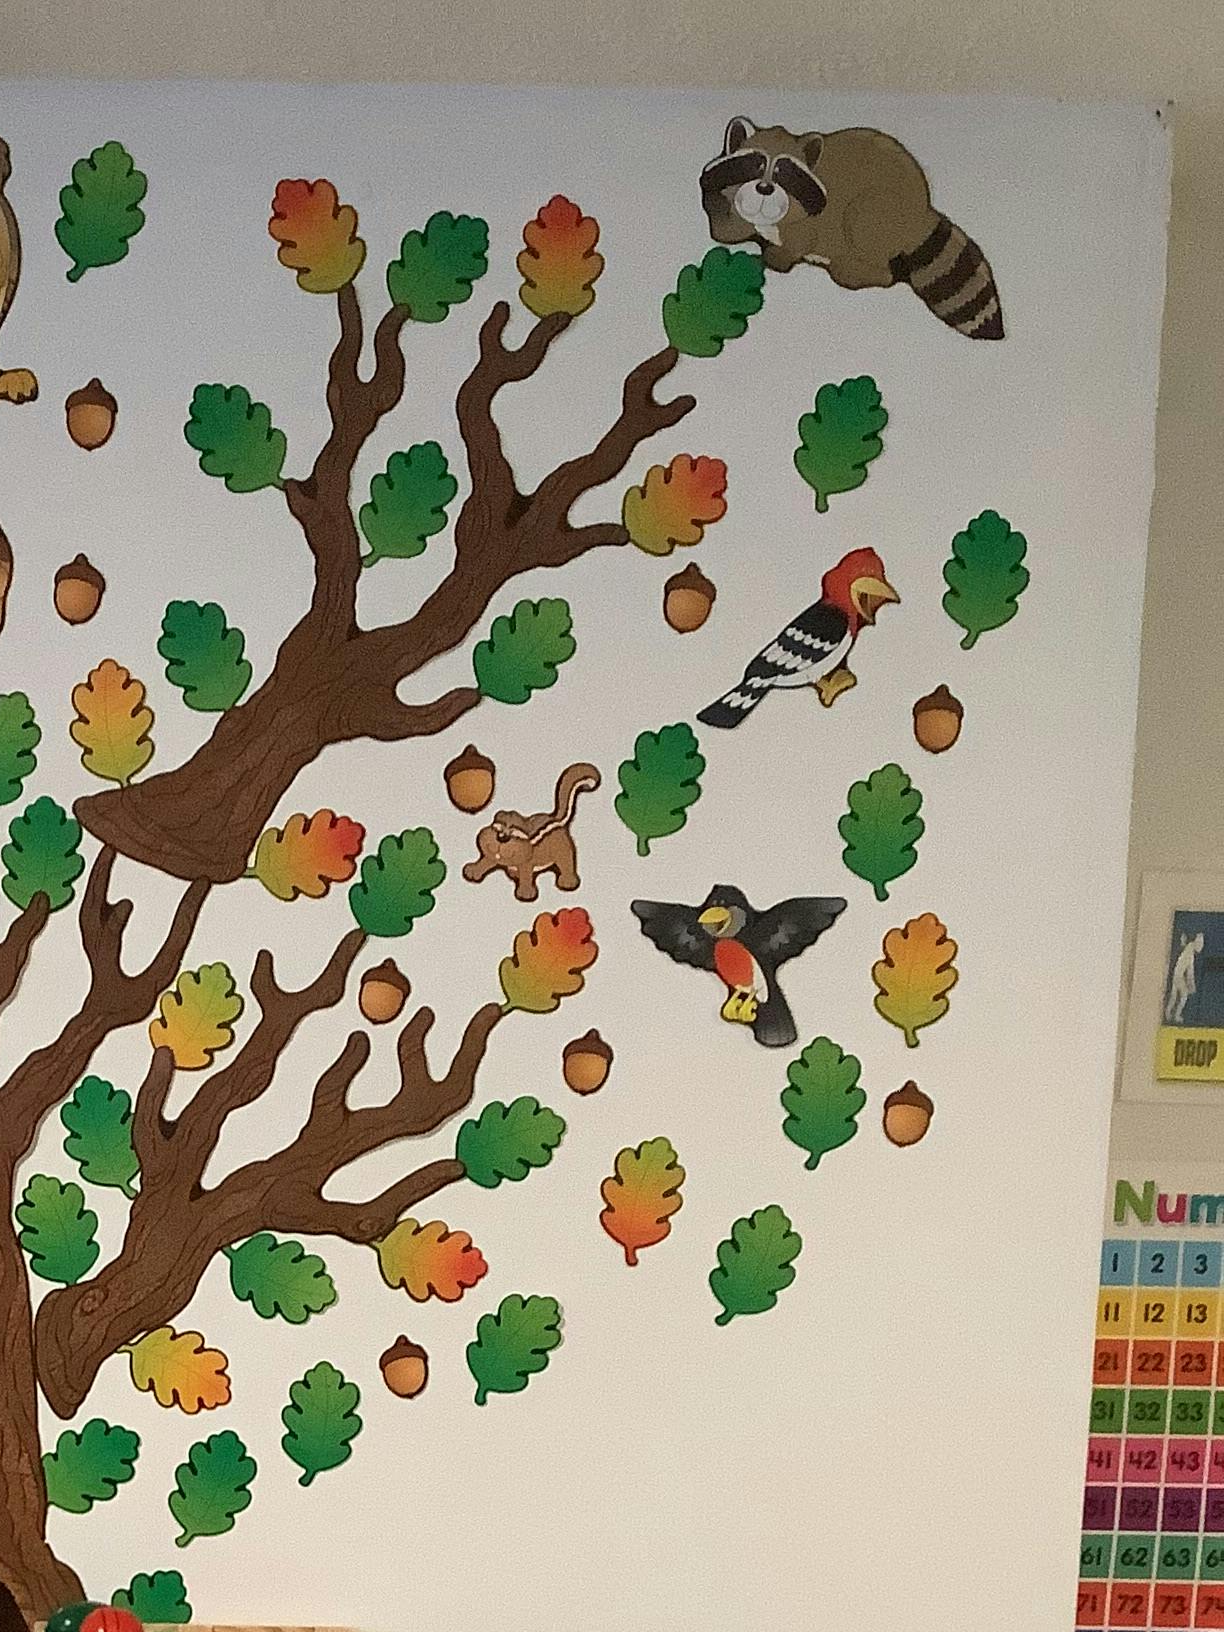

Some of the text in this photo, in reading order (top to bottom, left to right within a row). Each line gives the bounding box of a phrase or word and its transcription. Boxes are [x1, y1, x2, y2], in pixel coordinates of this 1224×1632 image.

[1112, 1252, 1208, 1275] 1 2 3
[1103, 1302, 1208, 1324] 11 12 13
[1097, 1351, 1119, 1371] 21
[1137, 1352, 1165, 1372] 22
[1180, 1353, 1207, 1373] 23
[1092, 1400, 1115, 1421] 31
[1134, 1401, 1161, 1422] 32
[1177, 1402, 1203, 1422] 33
[1089, 1450, 1112, 1469] 41
[1129, 1450, 1157, 1470] 42
[1171, 1451, 1200, 1472] 43
[1080, 1547, 1102, 1566] 61
[1121, 1547, 1148, 1568] 62
[1162, 1547, 1191, 1568] 63
[1078, 1593, 1097, 1612] 71
[1117, 1594, 1144, 1614] 72
[1160, 1595, 1187, 1615] 73
